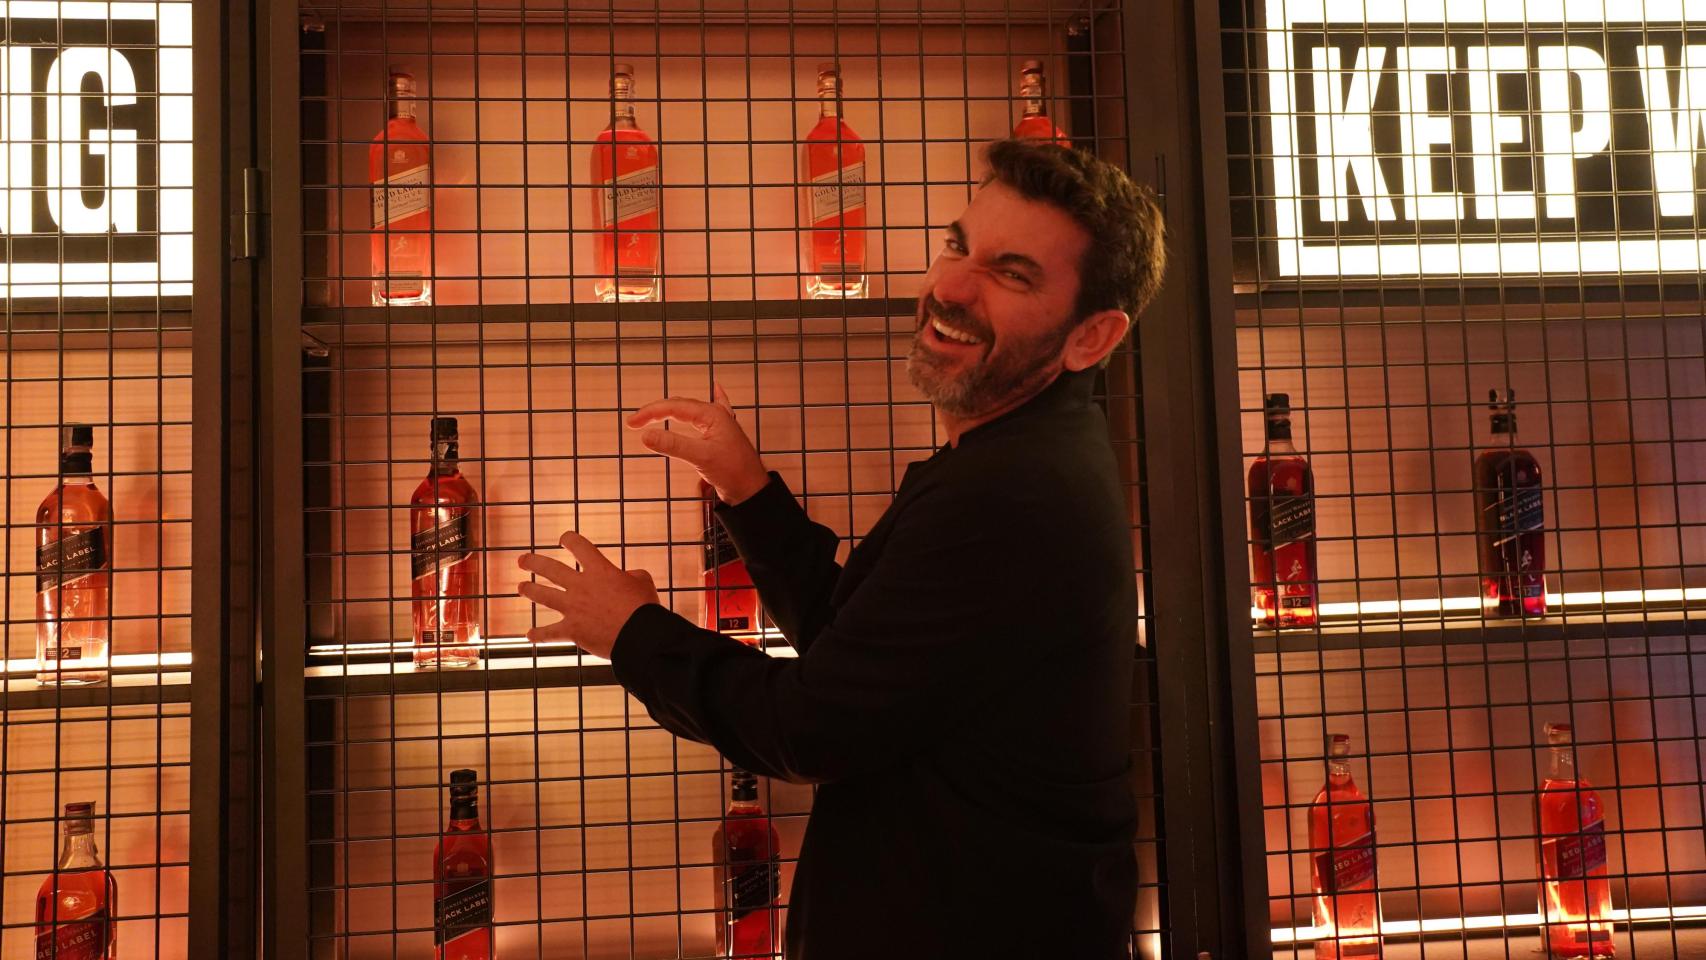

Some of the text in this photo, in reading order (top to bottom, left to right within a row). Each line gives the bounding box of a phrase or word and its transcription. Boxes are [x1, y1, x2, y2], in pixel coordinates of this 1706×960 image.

[1312, 45, 1612, 221] KEEP
[1272, 515, 1292, 528] LACK
[439, 533, 466, 548] LABEL
[66, 546, 97, 561] LABEL
[1291, 598, 1303, 608] 12
[729, 618, 740, 629] 12
[62, 929, 97, 949] LABEL
